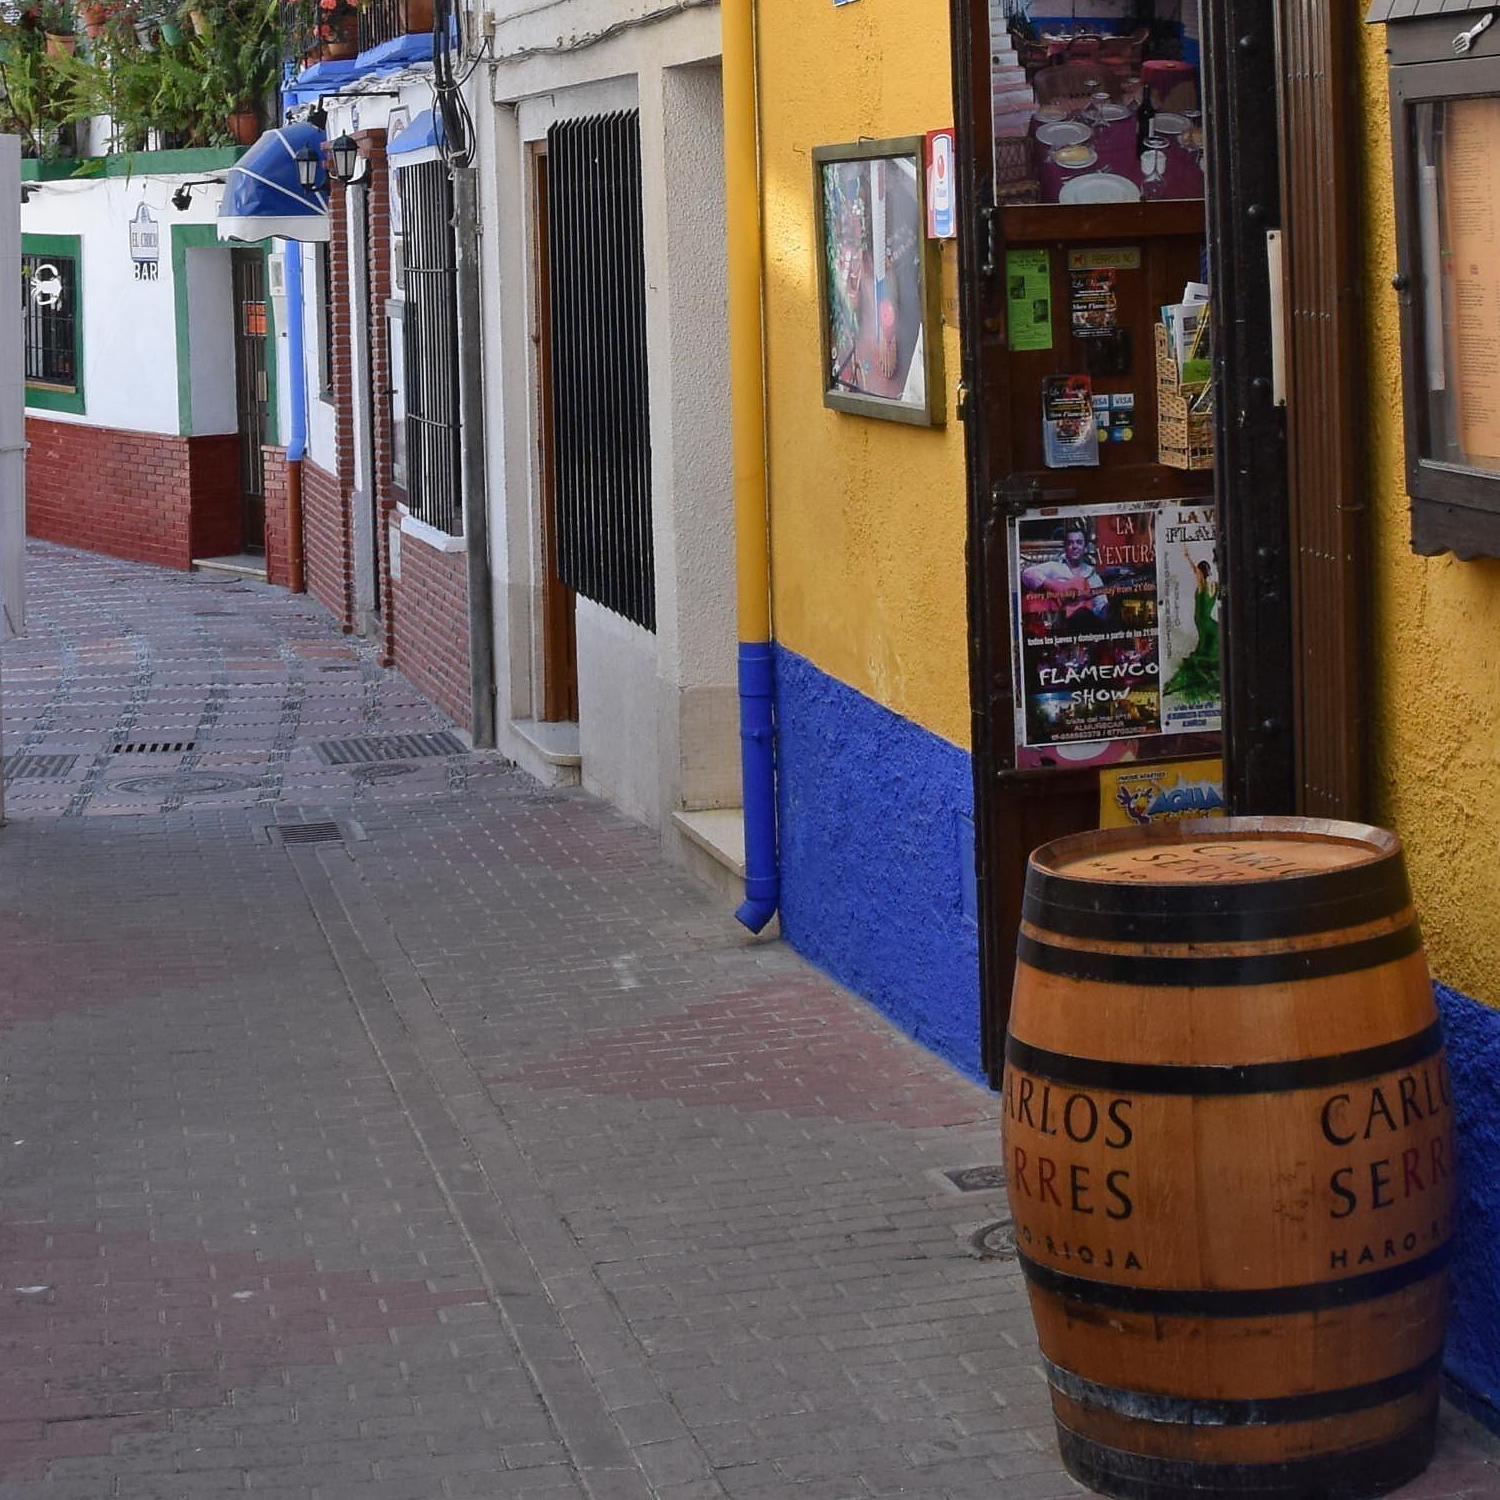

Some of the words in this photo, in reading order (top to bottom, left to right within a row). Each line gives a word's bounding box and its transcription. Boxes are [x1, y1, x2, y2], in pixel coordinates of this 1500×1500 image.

[133, 261, 158, 280] BAR
[1115, 395, 1132, 405] VISA
[1116, 516, 1134, 535] LA
[1178, 512, 1199, 524] LA
[1097, 544, 1157, 565] VENTURA
[1027, 637, 1043, 646] todos
[1039, 662, 1159, 686] FLAMENCO
[1071, 686, 1131, 705] SHOW
[1330, 1137, 1449, 1219] SERR
